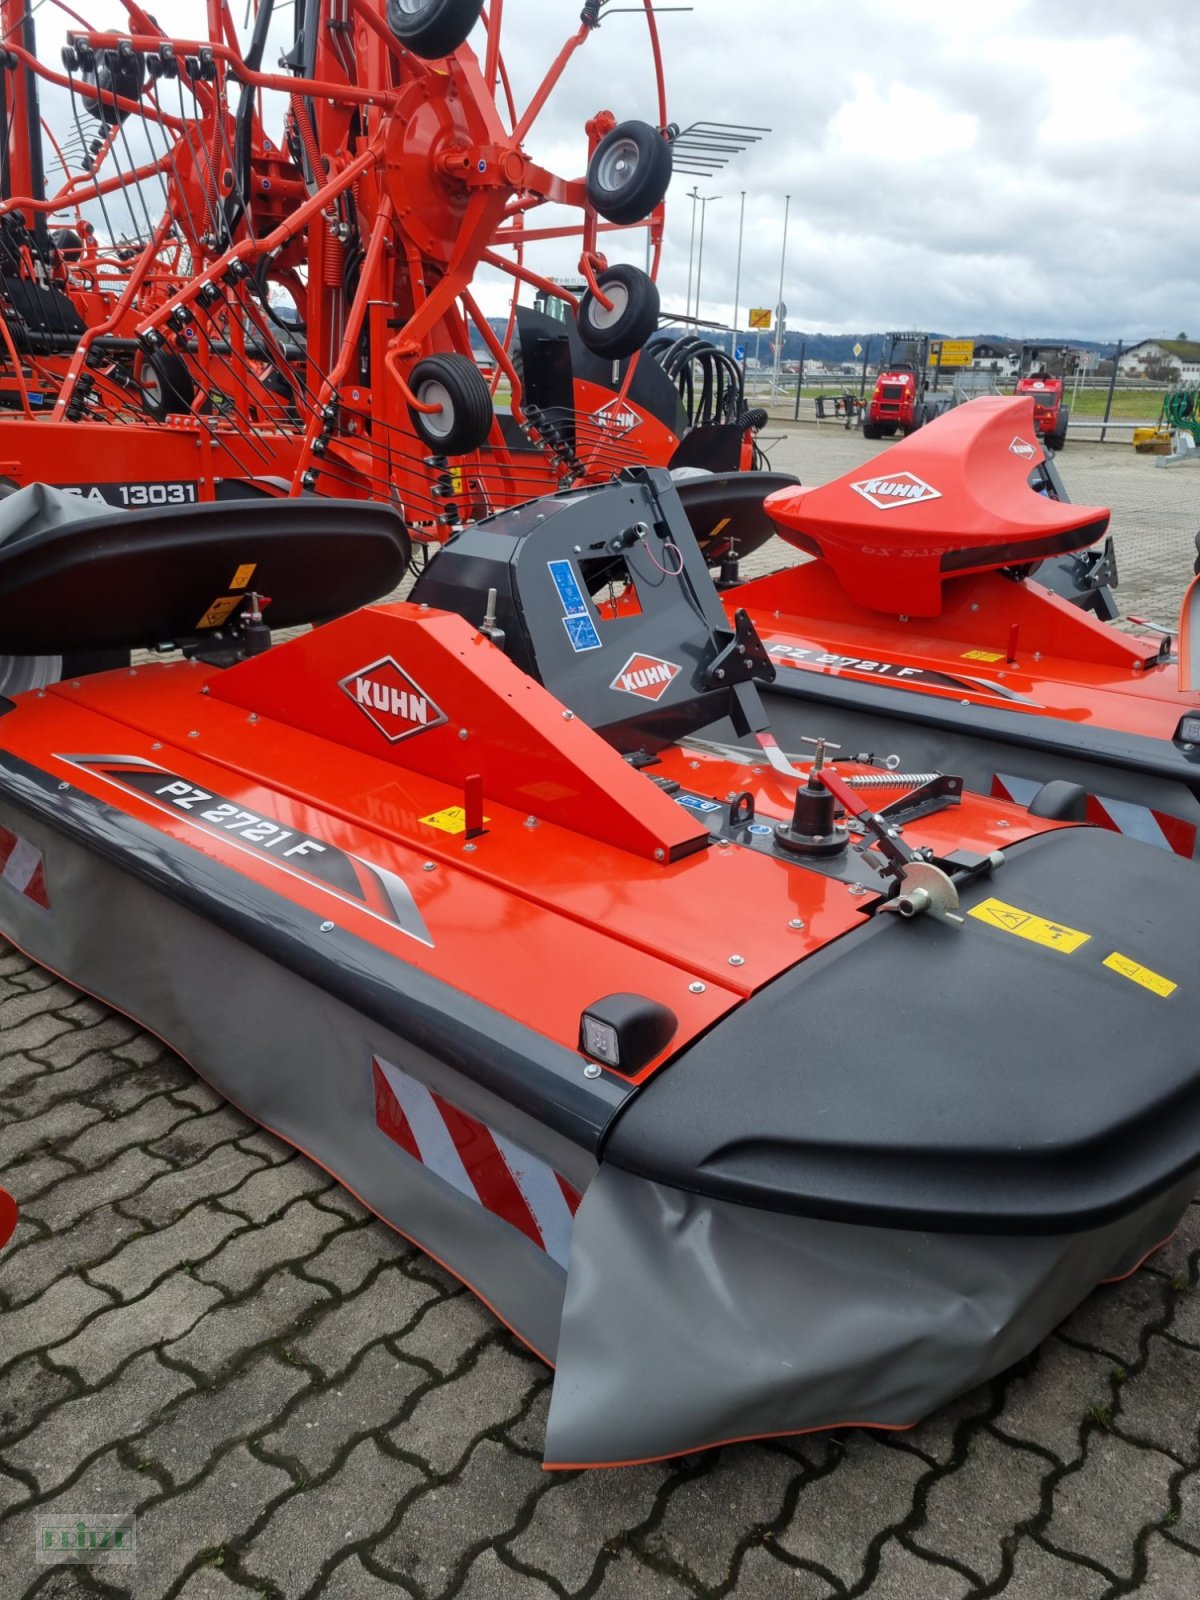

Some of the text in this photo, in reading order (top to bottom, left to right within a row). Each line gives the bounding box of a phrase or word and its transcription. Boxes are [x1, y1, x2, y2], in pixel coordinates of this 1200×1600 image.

[119, 484, 195, 505] 13031
[864, 480, 927, 498] KUHN
[770, 644, 924, 676] PZ 2721 F
[621, 663, 672, 691] KUHN
[356, 676, 427, 726] KUHN
[154, 780, 327, 857] PZ 2721 F
